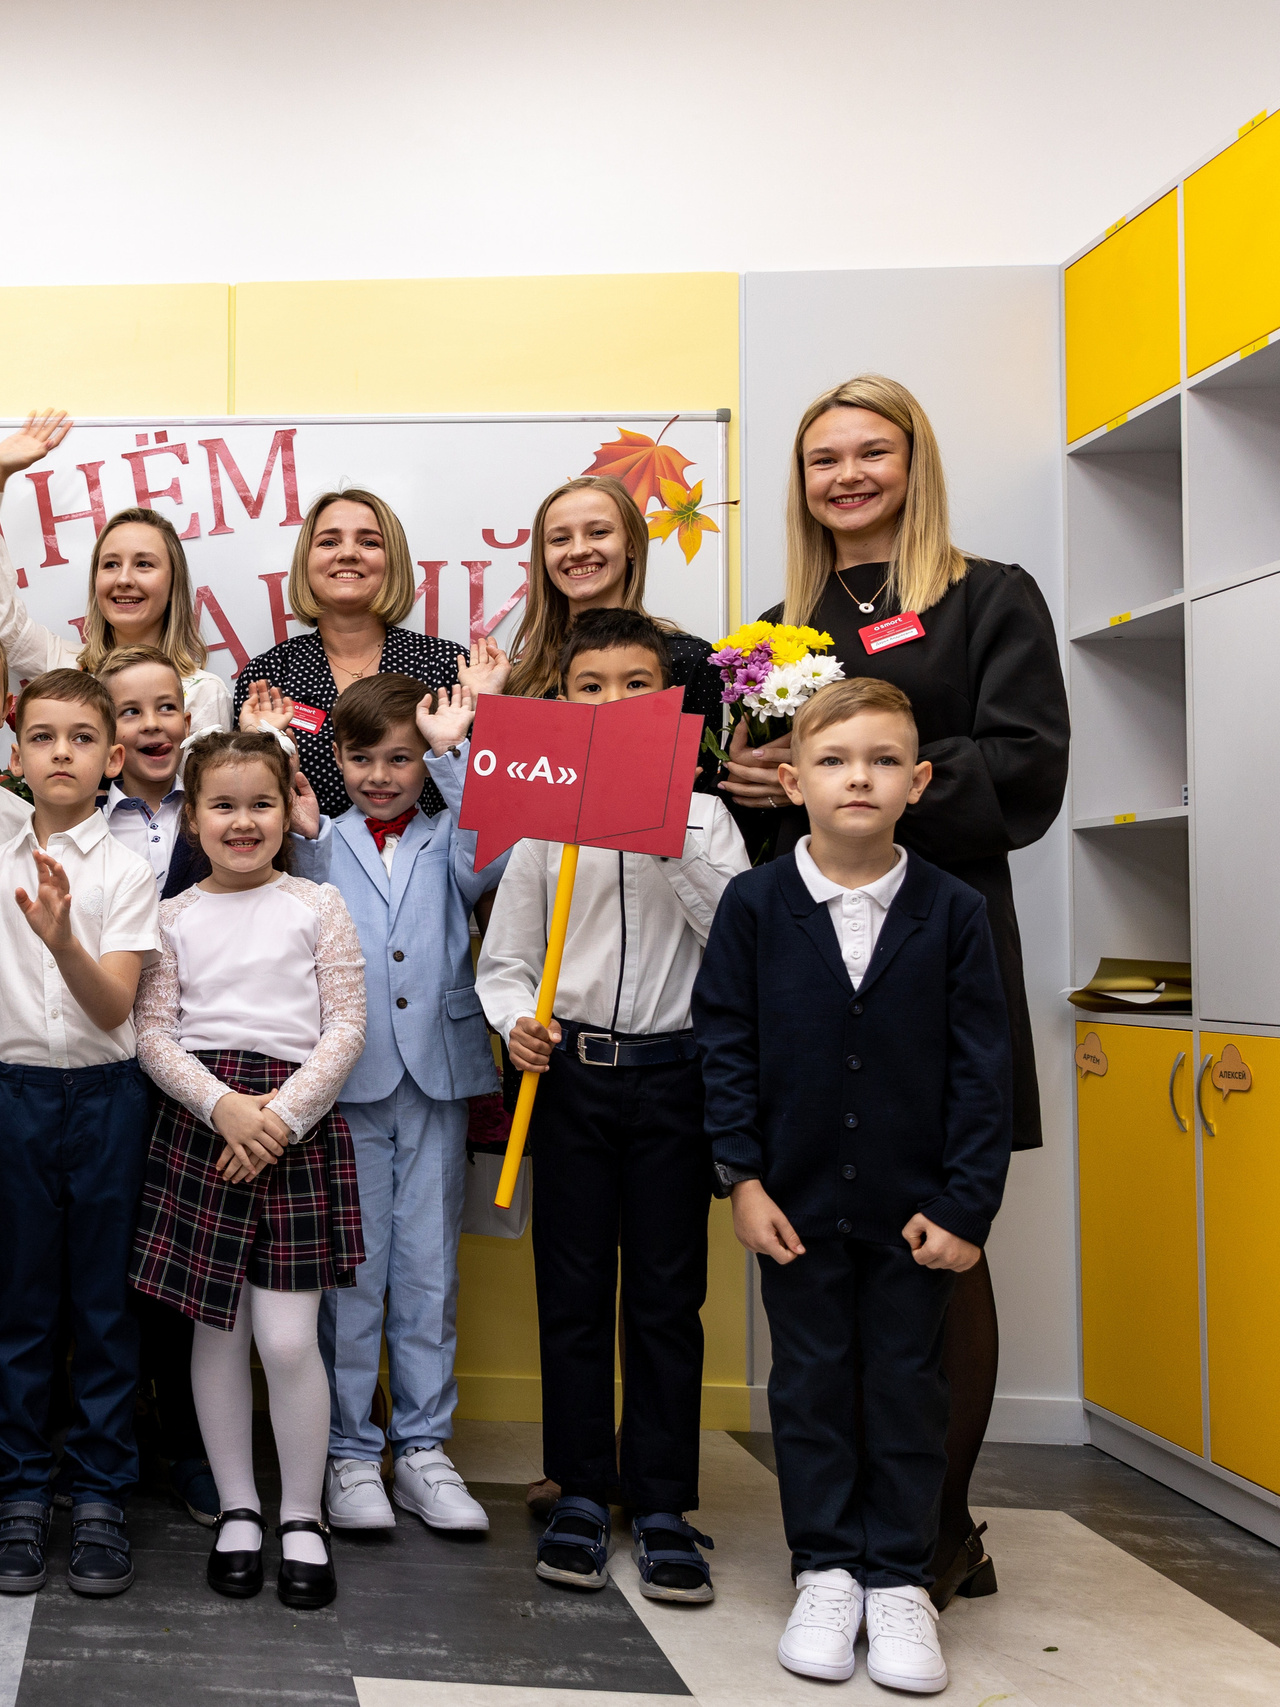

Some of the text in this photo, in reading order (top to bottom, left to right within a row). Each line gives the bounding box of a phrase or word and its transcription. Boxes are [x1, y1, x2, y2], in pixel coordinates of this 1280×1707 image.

[880, 617, 903, 629] smart
[300, 705, 316, 715] smart
[473, 749, 578, 785] 0 «А»
[1083, 1053, 1100, 1065] АРТЁМ
[1219, 1070, 1247, 1080] АЛЕКСЕЙ
